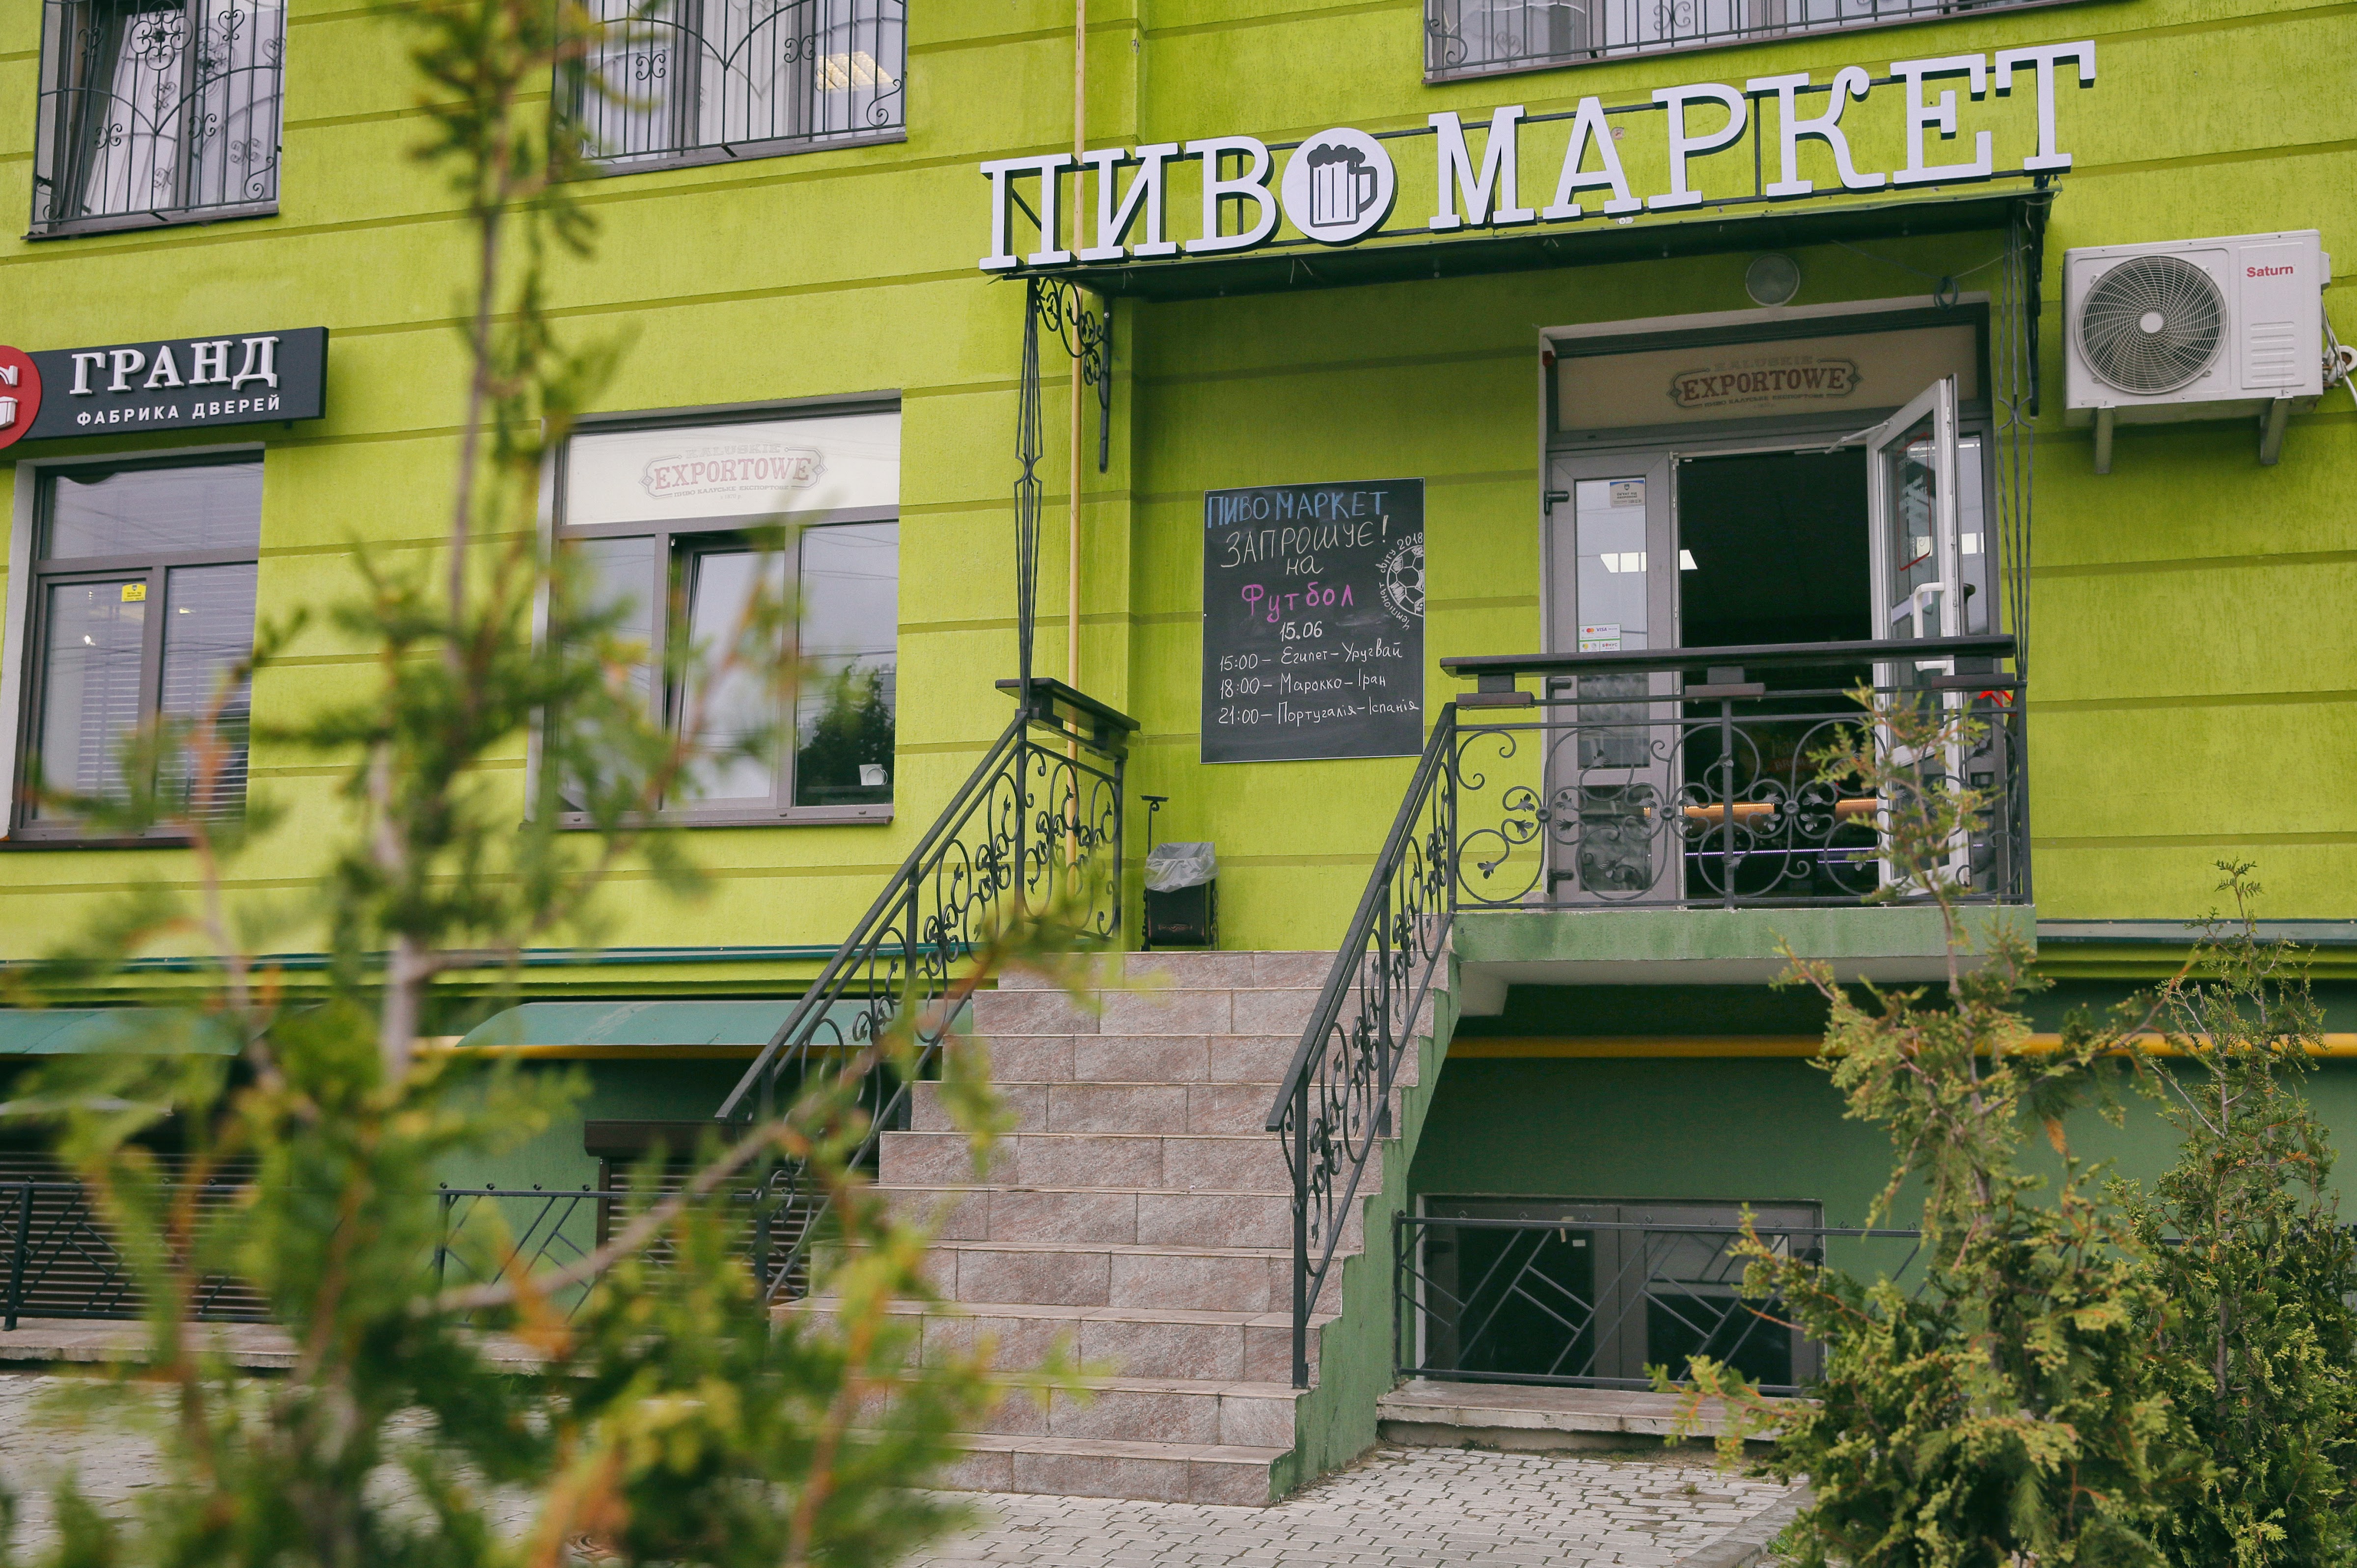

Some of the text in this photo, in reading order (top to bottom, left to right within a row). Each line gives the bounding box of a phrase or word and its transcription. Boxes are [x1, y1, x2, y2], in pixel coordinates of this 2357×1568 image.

[1428, 40, 2096, 231] МАРКЕТ
[2246, 264, 2294, 278] Saturn
[69, 336, 279, 396] ГРАНД
[1681, 368, 1846, 401] EXPORTOWE
[77, 394, 280, 427] ФАБРИКА ДВЕРЕЙ
[686, 443, 781, 459] KALUSKIE
[654, 457, 812, 489] EXPORTOWE
[697, 486, 737, 494] КАЛУСЬКЕ
[1397, 532, 1423, 550] 2018
[1286, 555, 1324, 575] на
[1241, 581, 1353, 622] Футбол
[1280, 621, 1323, 642] 15.06
[1219, 654, 1259, 672] 15:00
[1220, 677, 1260, 699] 18:00
[1280, 673, 1342, 695] Марокко
[1218, 705, 1259, 725] 21:00
[1278, 701, 1357, 727] Португалія
